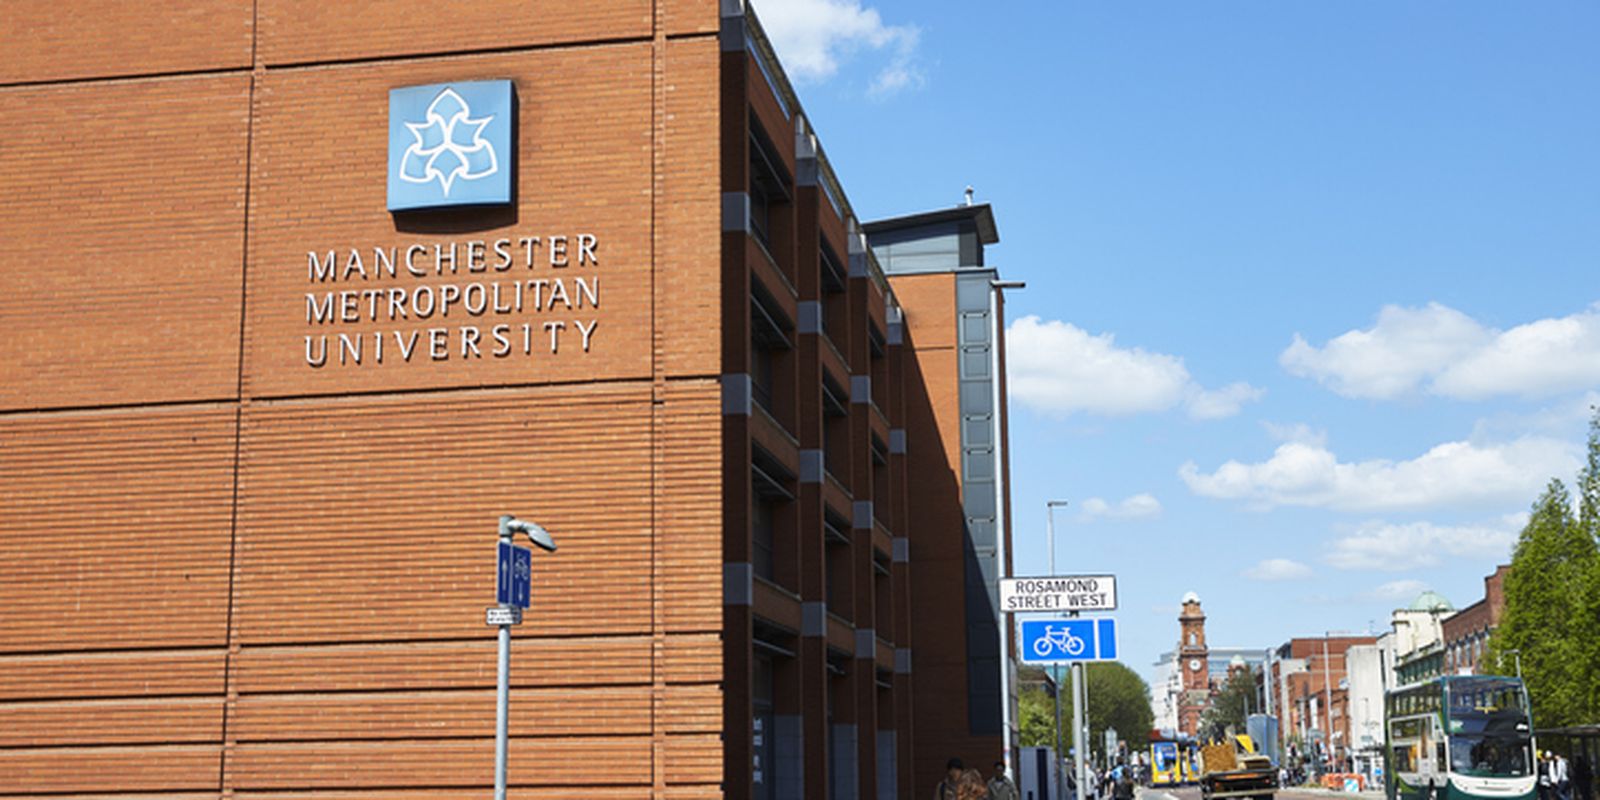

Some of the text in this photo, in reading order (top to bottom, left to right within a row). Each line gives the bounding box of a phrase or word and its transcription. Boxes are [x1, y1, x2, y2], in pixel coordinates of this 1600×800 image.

[307, 233, 598, 282] MANCHESTER
[305, 276, 599, 324] METROPOLITAN
[304, 319, 598, 367] UNIVERSITY
[1007, 592, 1107, 609] STREET WEST
[1015, 579, 1098, 594] ROSAMOND
